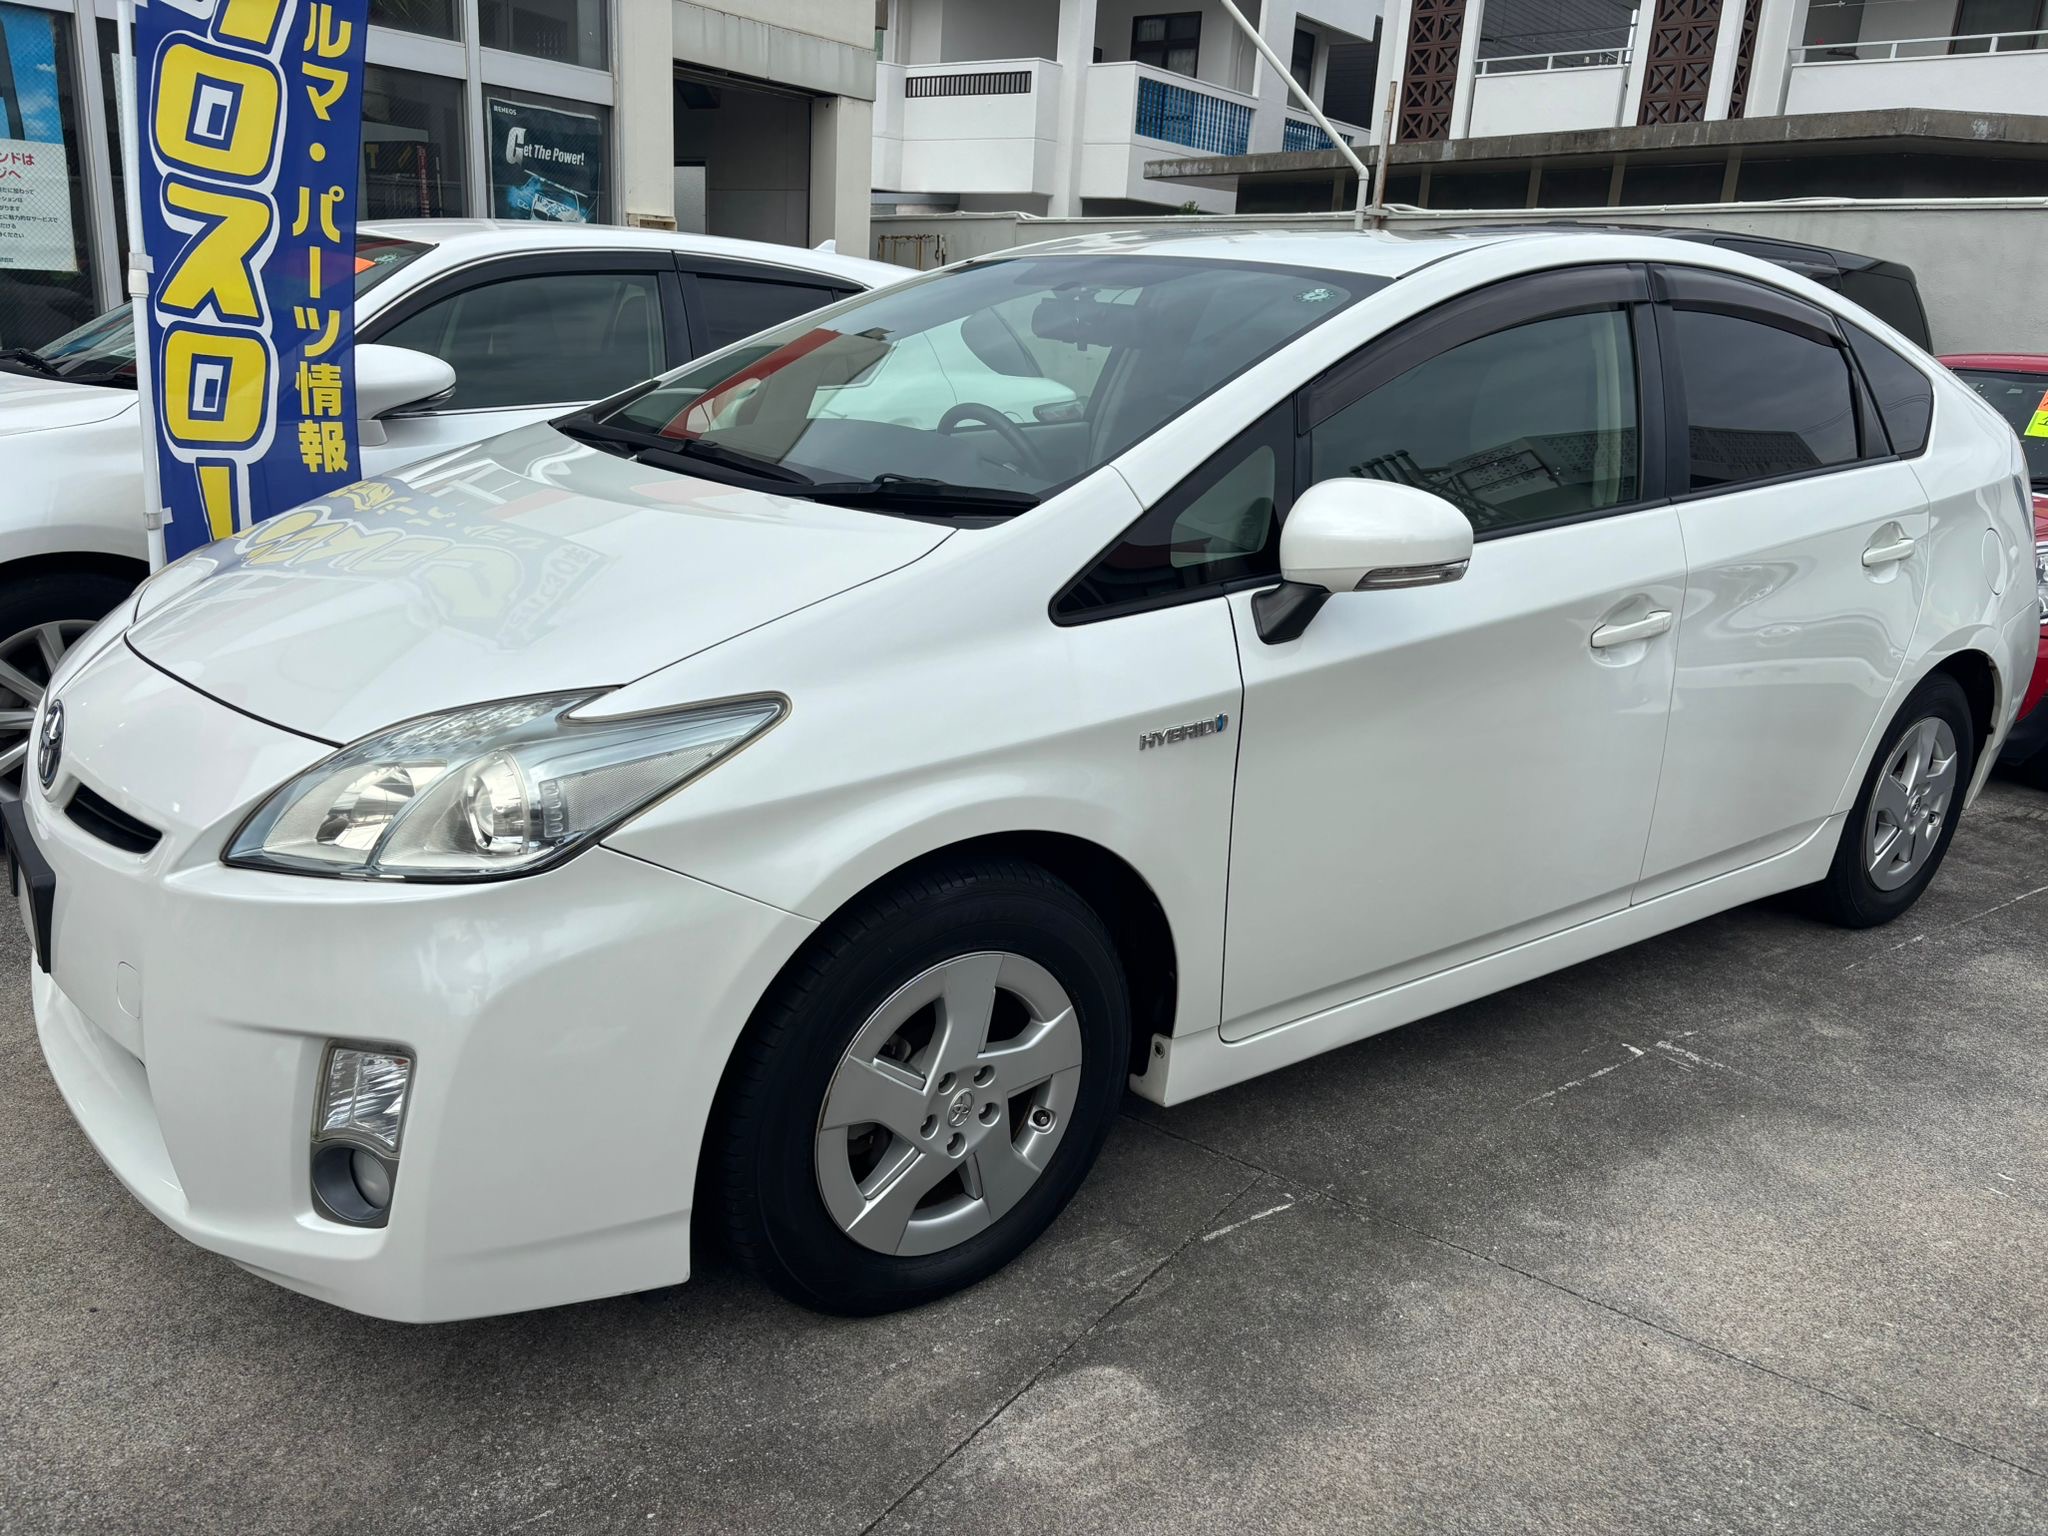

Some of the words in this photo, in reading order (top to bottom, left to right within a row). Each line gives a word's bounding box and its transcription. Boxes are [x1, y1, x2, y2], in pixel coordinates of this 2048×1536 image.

[506, 127, 532, 165] Get
[534, 144, 552, 161] The
[553, 148, 585, 166] Power!
[1139, 718, 1215, 751] HYBRID
